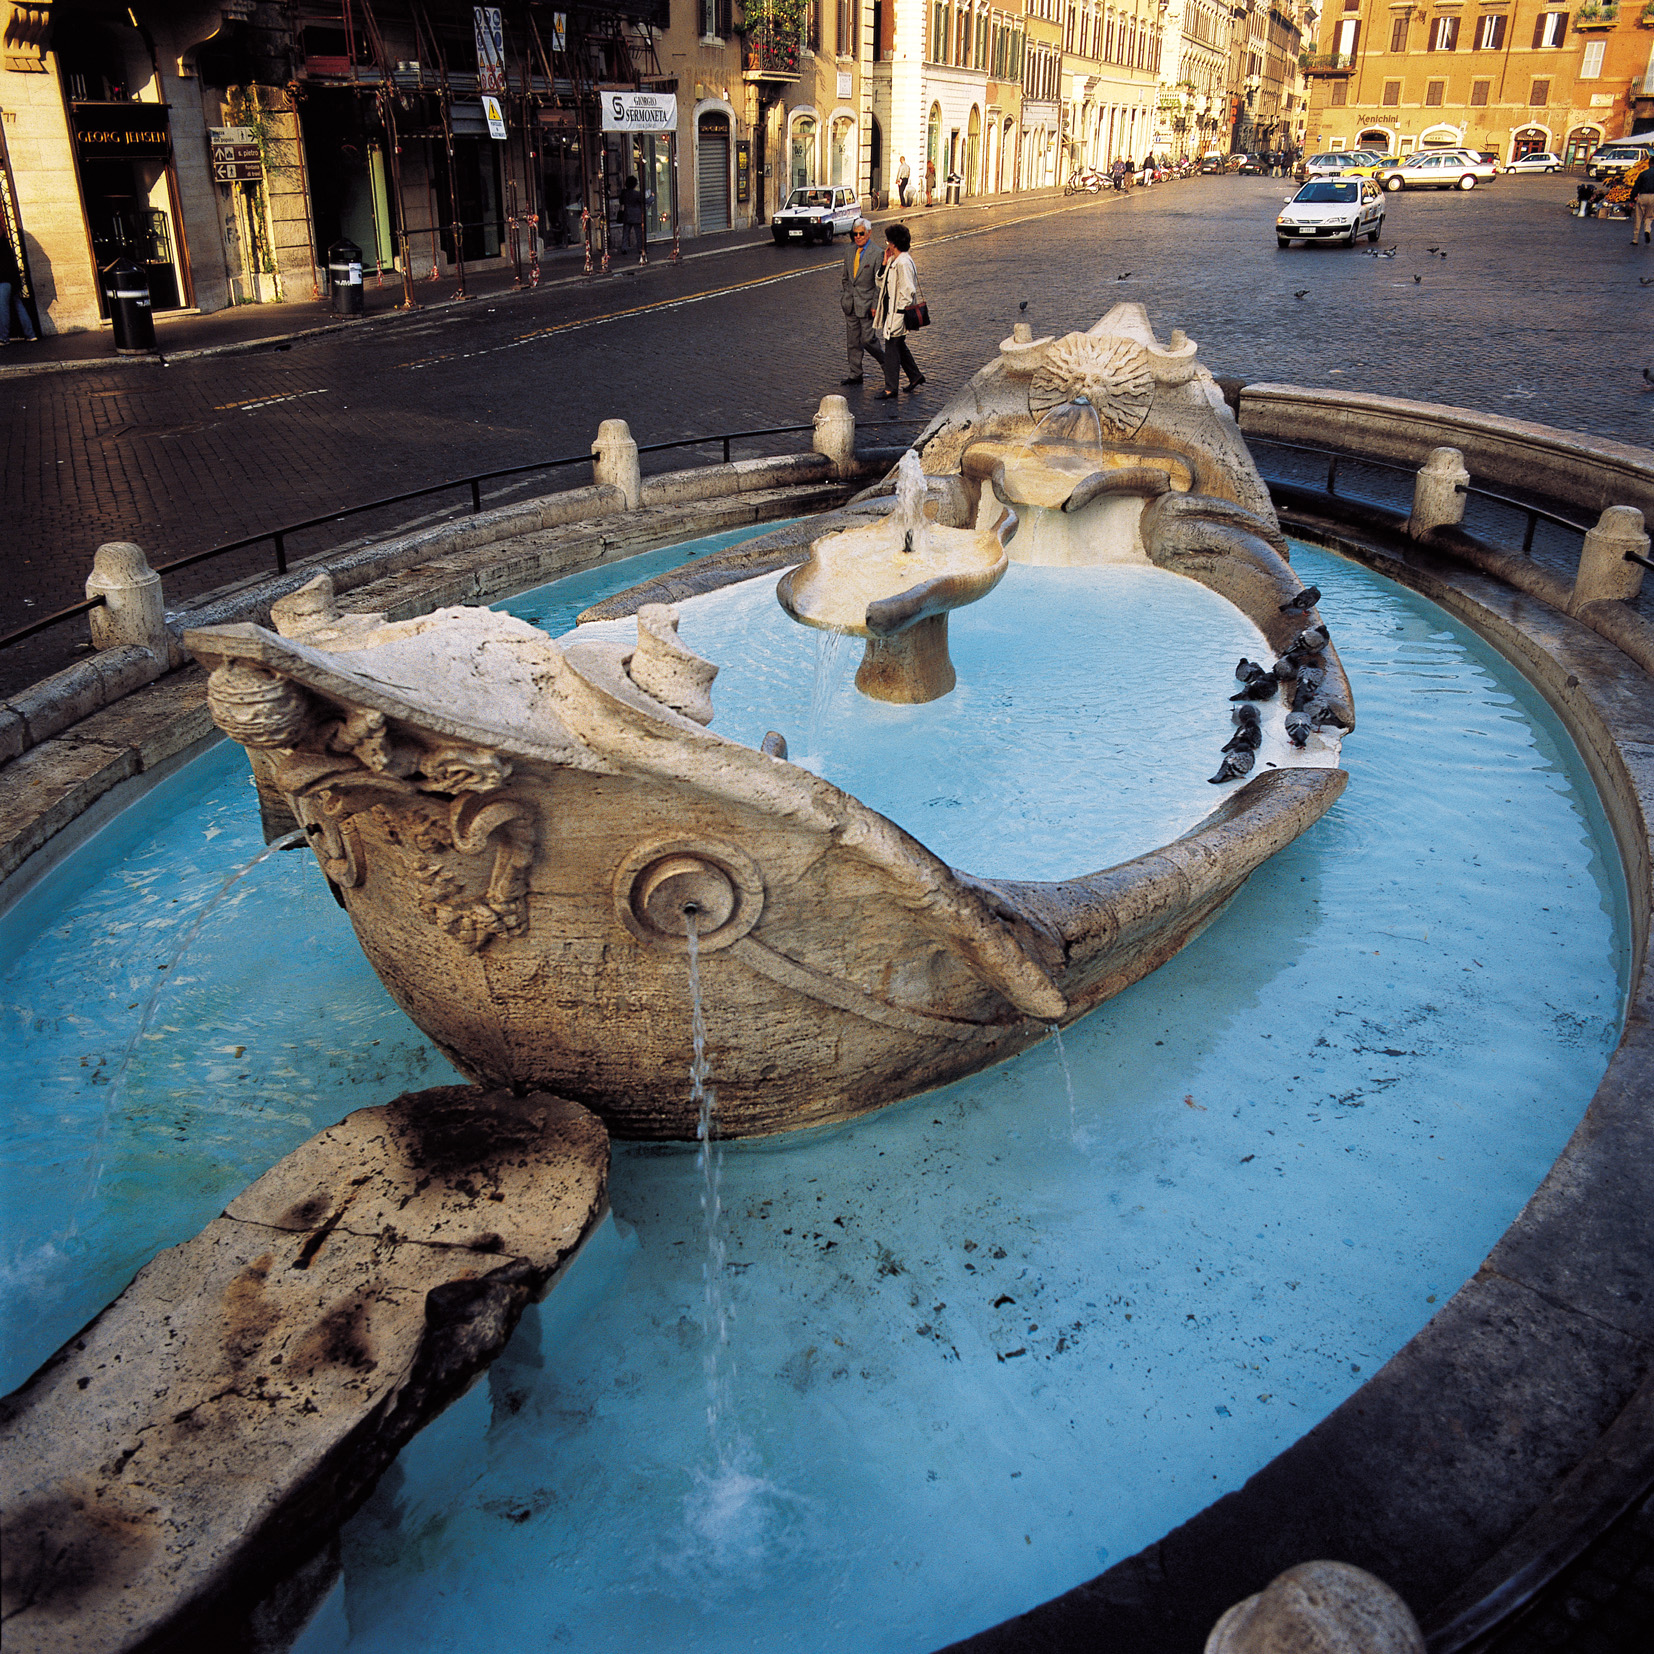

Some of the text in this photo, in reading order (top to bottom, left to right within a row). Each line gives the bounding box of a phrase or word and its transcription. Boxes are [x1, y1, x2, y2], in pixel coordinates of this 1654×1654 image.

[634, 97, 657, 106] GIORGIO
[3, 112, 16, 123] 77
[626, 110, 668, 122] SERMONETA
[1357, 114, 1399, 125] Menichini
[78, 131, 166, 144] GEORG JENSEN
[243, 149, 259, 157] pietro
